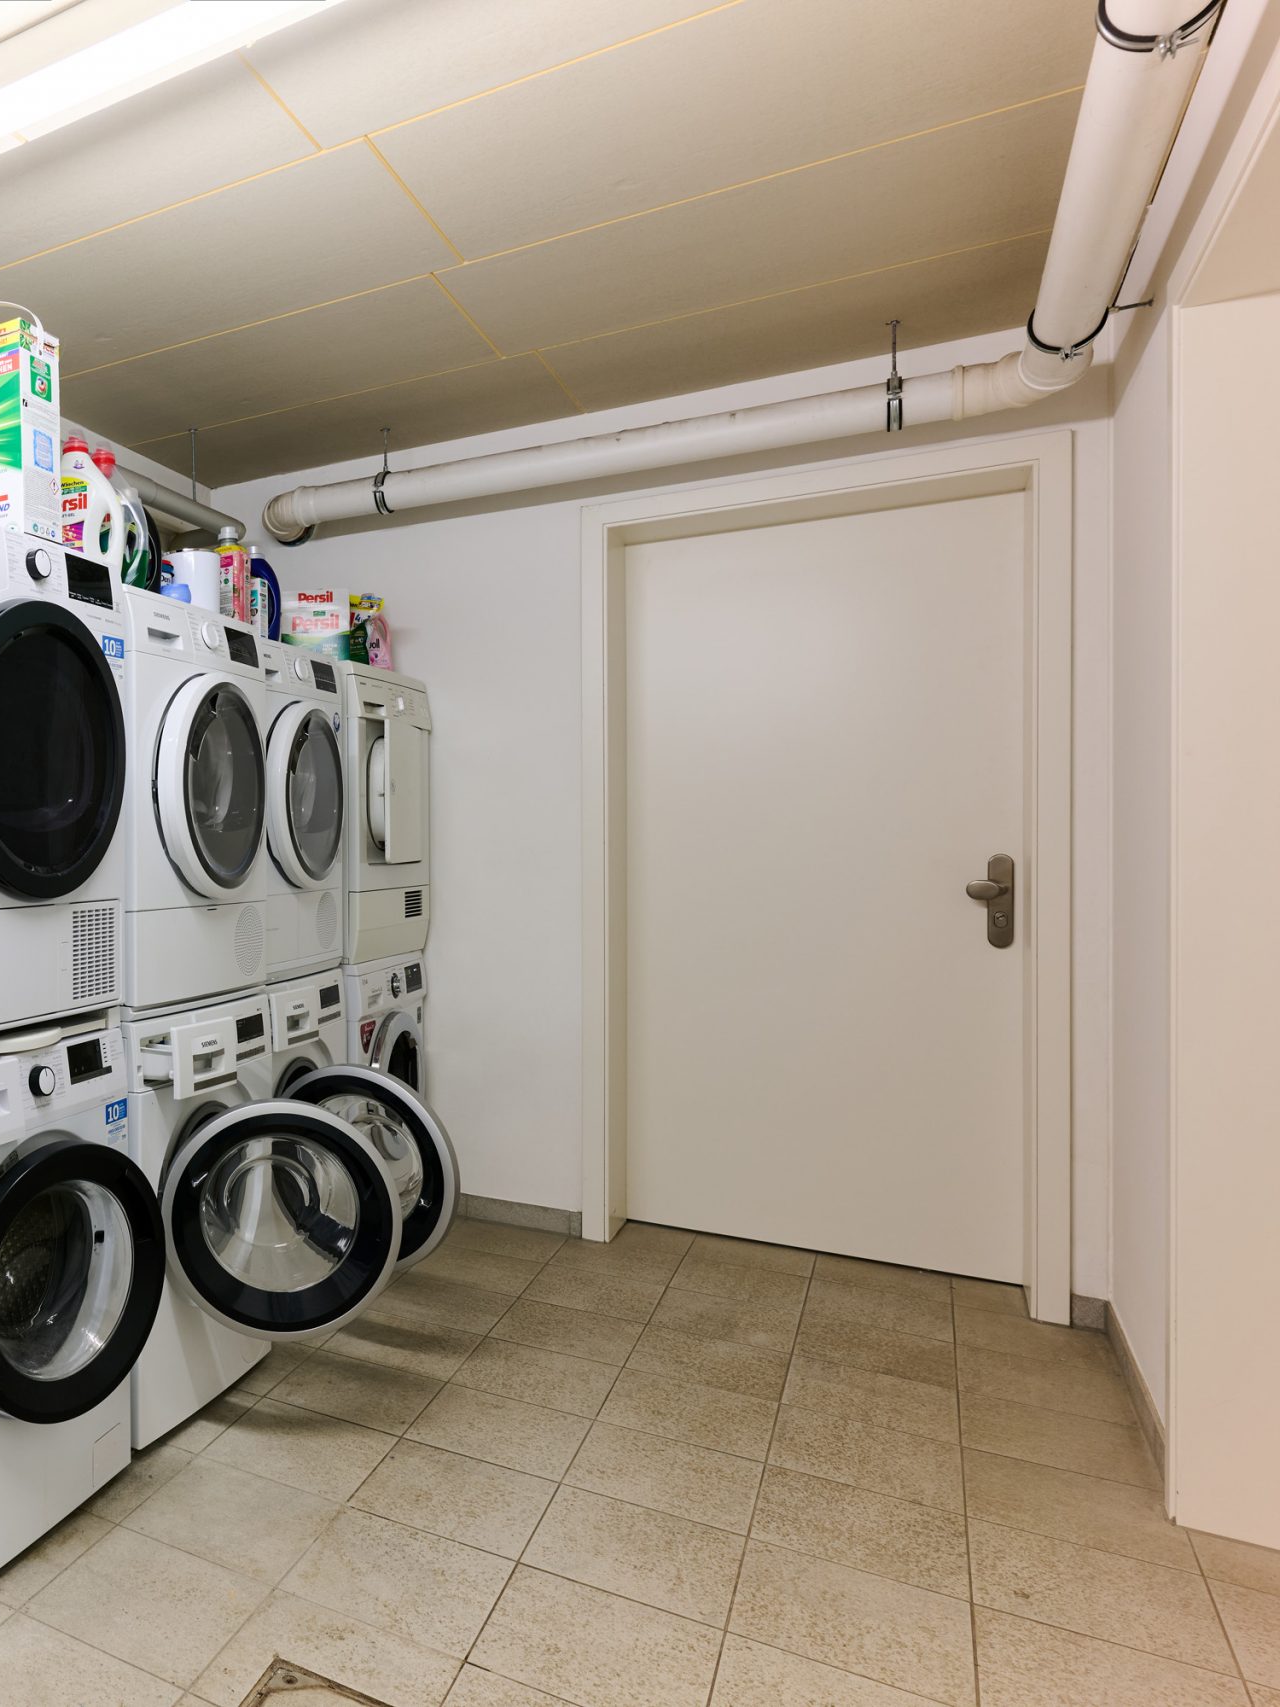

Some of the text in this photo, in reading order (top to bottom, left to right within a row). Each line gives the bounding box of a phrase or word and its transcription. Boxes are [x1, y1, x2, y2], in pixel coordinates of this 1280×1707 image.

[62, 492, 88, 512] rsil
[297, 590, 333, 604] Persil
[291, 613, 339, 632] Persil
[107, 1104, 120, 1122] 10
